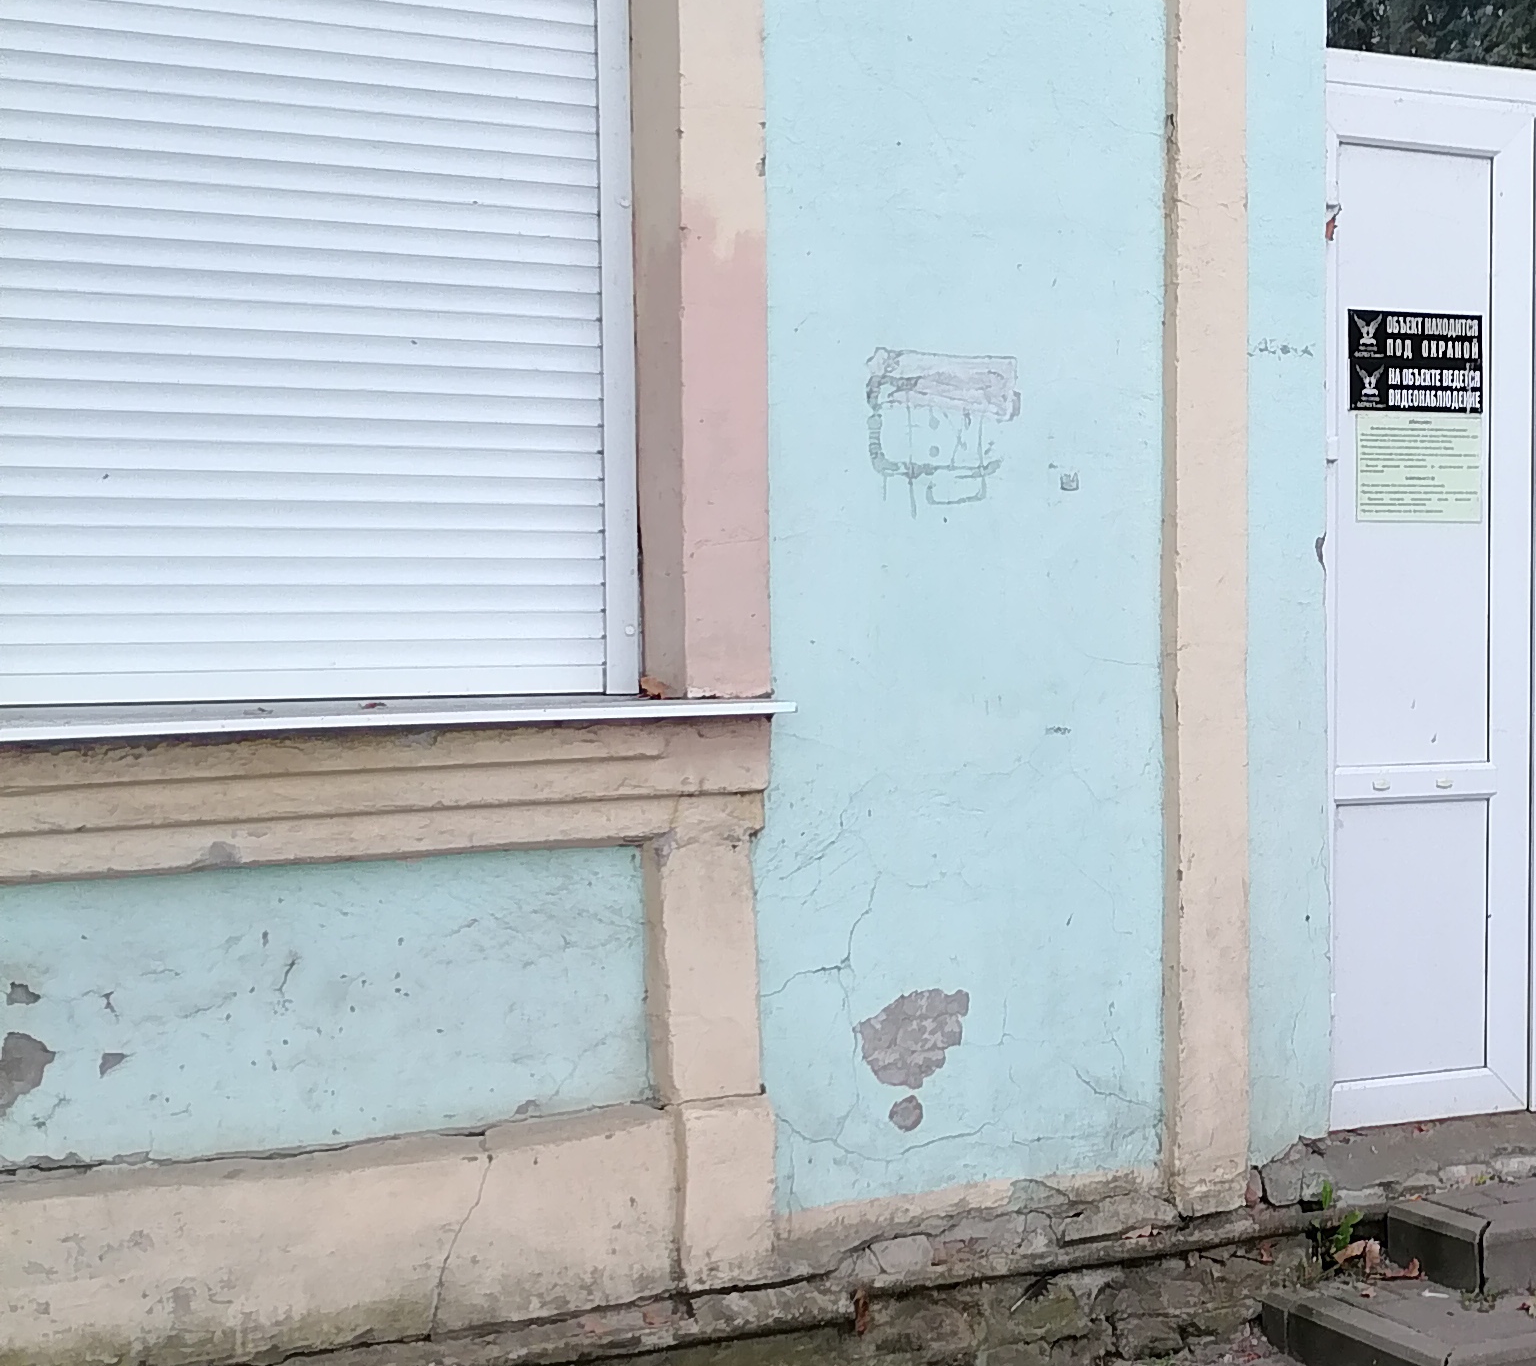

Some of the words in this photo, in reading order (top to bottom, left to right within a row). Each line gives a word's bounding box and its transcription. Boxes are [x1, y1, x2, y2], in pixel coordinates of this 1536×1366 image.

[1386, 315, 1423, 335] ОБЪЕКТ
[1424, 317, 1479, 338] НАХОДИТСЯ
[1386, 338, 1413, 359] ПОД
[1421, 337, 1479, 359] ОХРАНОЙ
[1388, 367, 1401, 385] НА
[1402, 368, 1441, 386] ОБЪЕКТЕ
[1388, 388, 1481, 410] ВИДЕОНАБЛЮДЕНИЕ
